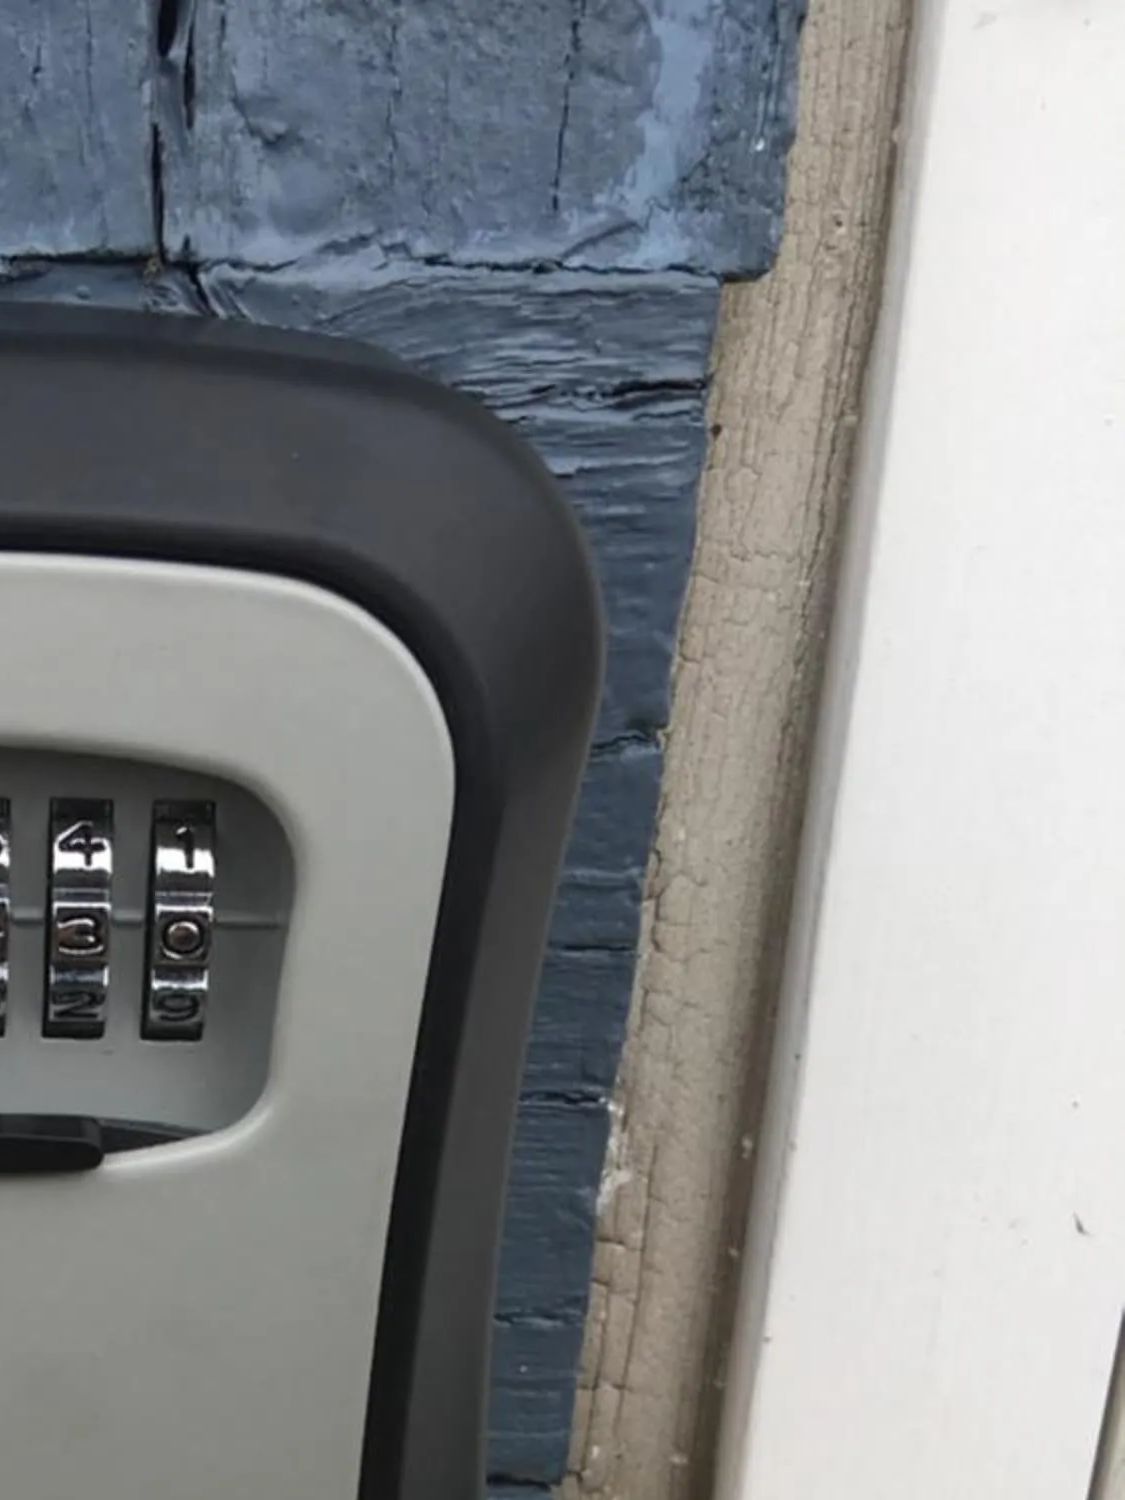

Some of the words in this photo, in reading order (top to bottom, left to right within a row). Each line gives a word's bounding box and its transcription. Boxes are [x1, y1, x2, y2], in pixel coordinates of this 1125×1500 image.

[57, 821, 108, 867] 4
[174, 821, 196, 870] 1
[56, 914, 105, 956] 3
[160, 917, 205, 959] 0
